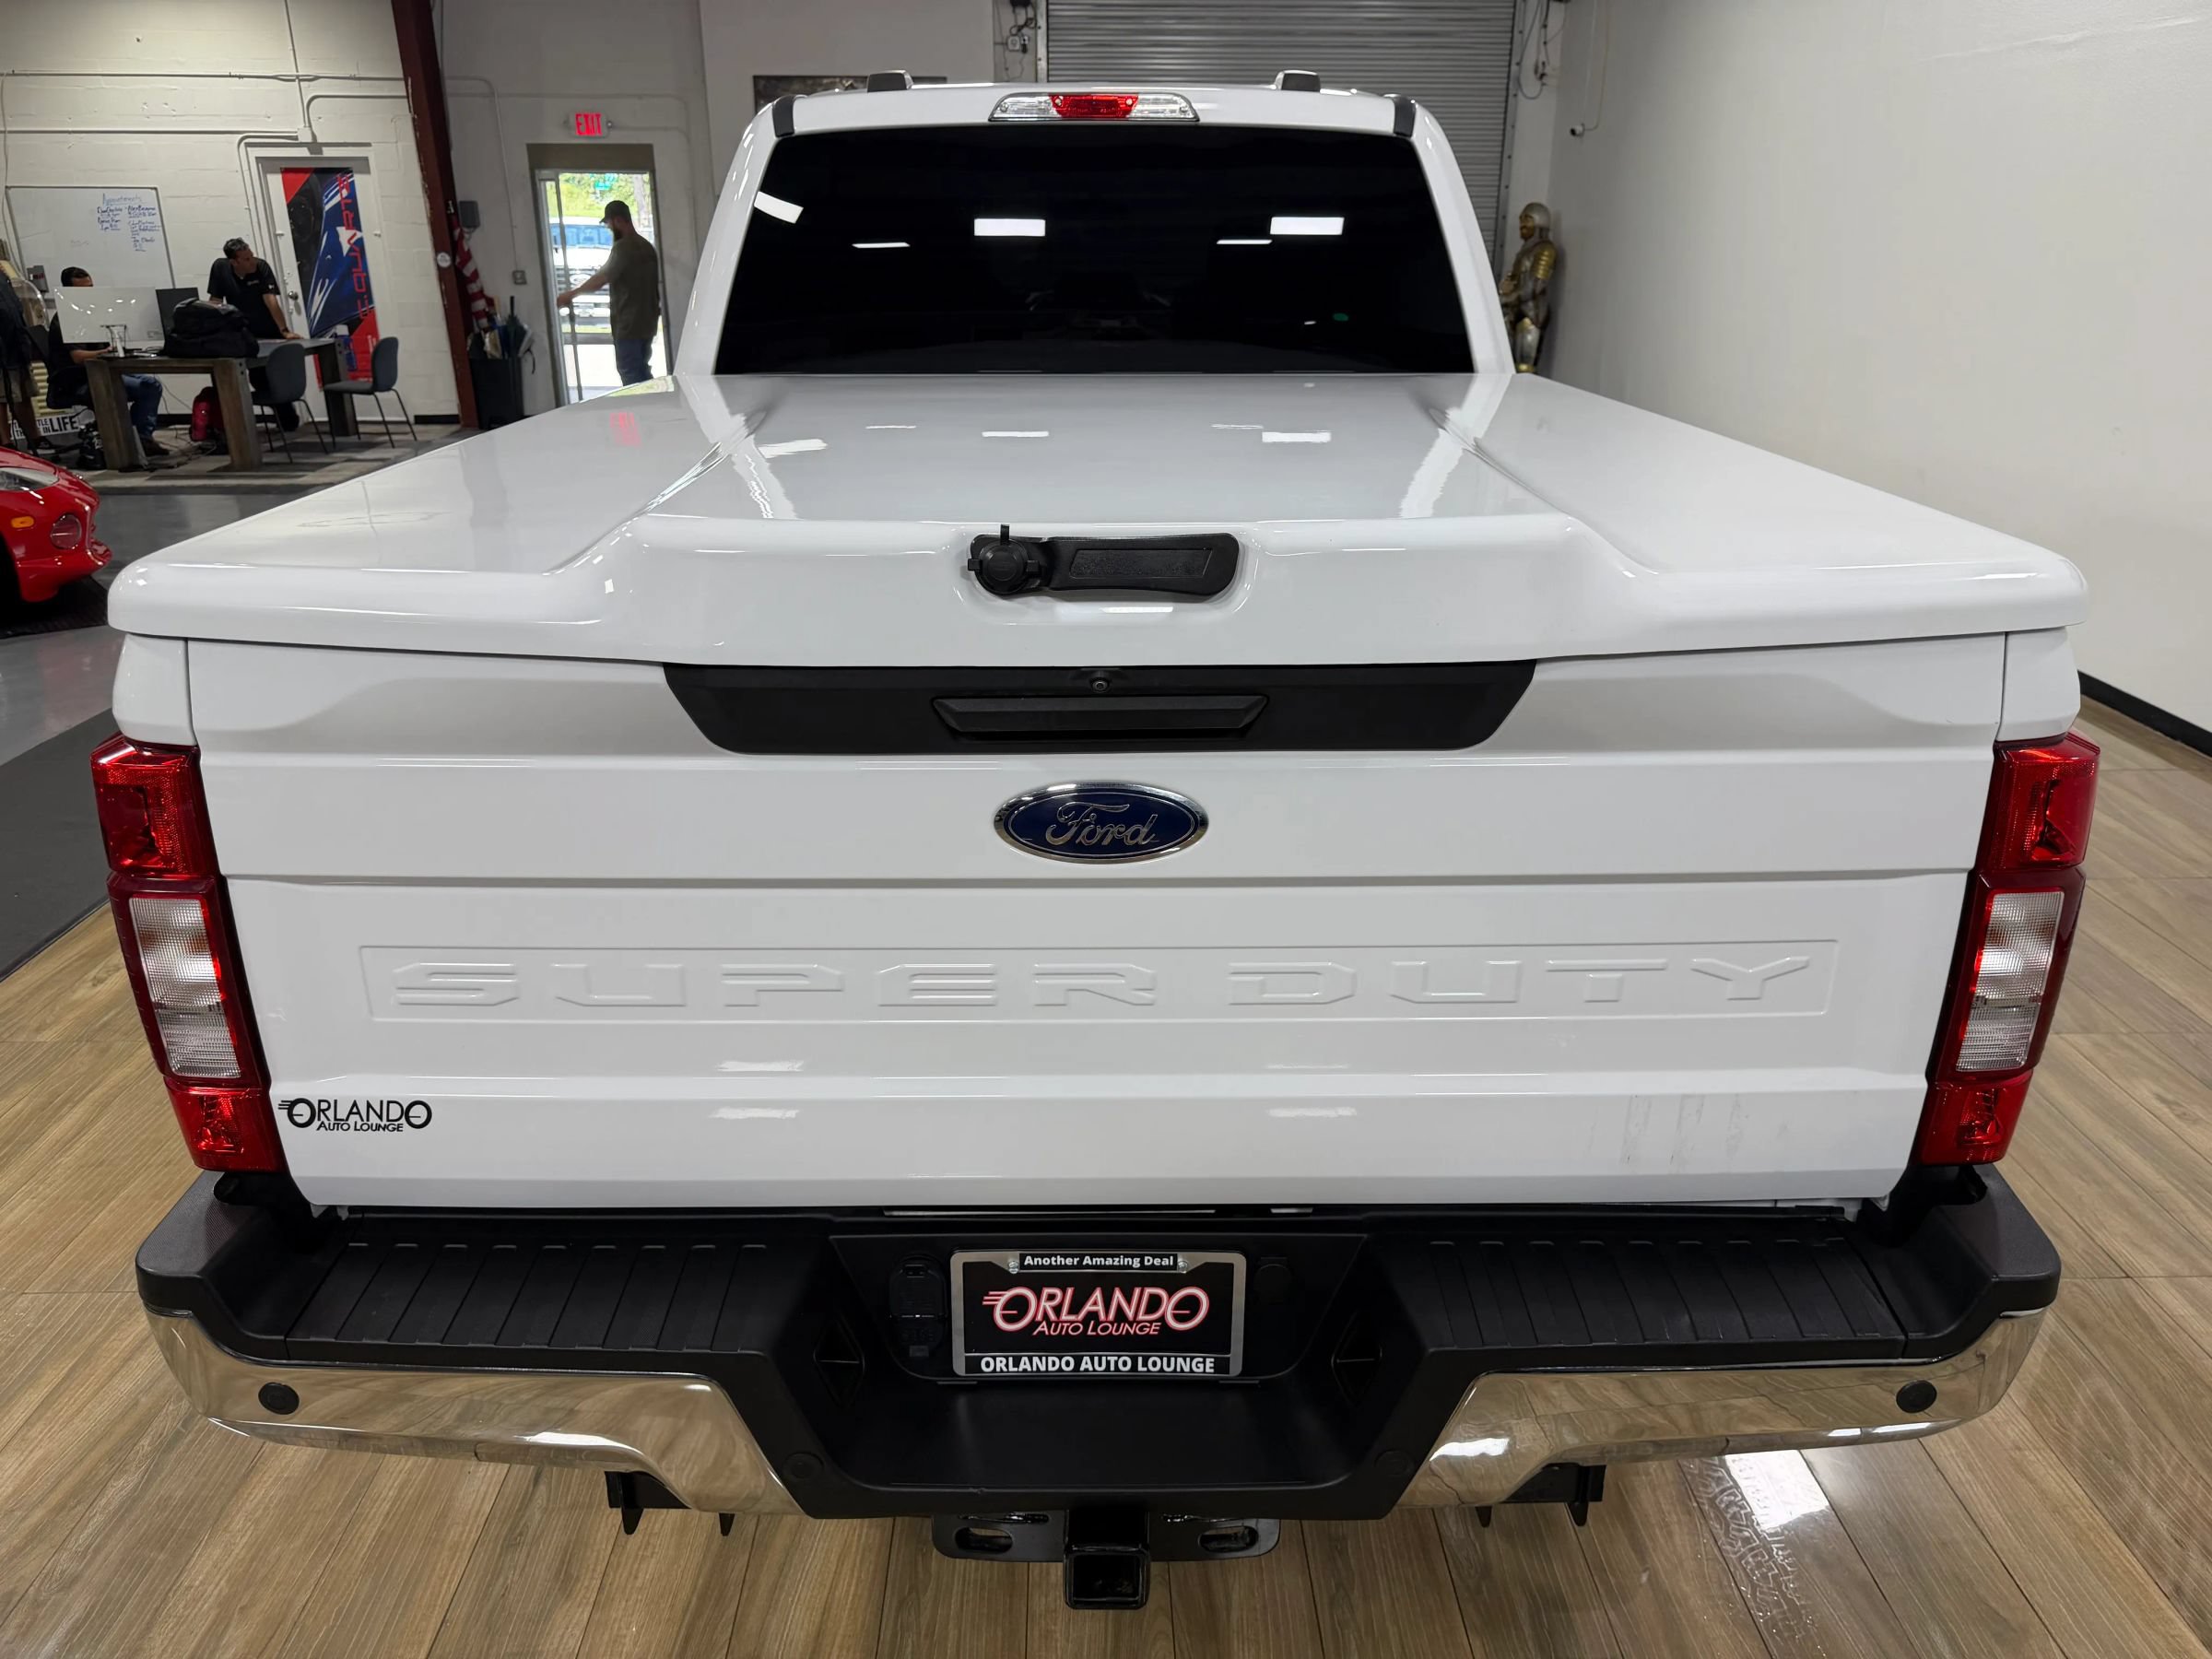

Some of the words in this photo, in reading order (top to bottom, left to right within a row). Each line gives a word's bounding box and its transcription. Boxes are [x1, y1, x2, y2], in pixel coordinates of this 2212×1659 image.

[575, 112, 602, 136] EXIT
[49, 416, 78, 432] LIFE
[1045, 801, 1159, 846] Ford
[392, 962, 1158, 1006] SUPER
[1228, 956, 1810, 1005] DUTY
[286, 1097, 432, 1129] ORLANDO
[316, 1121, 350, 1131] AUTO
[354, 1121, 404, 1132] LOUNGE
[1024, 1255, 1079, 1266] Another
[1082, 1255, 1141, 1268] Amazing
[1144, 1255, 1174, 1266] Deal
[990, 1286, 1209, 1332] ORLANDO
[1032, 1321, 1083, 1335] AUTO
[1086, 1321, 1162, 1335] LOUNGE
[980, 1356, 1075, 1372] ORLANDO
[1079, 1356, 1132, 1372] AUTO
[1137, 1357, 1215, 1373] LOUNGE
